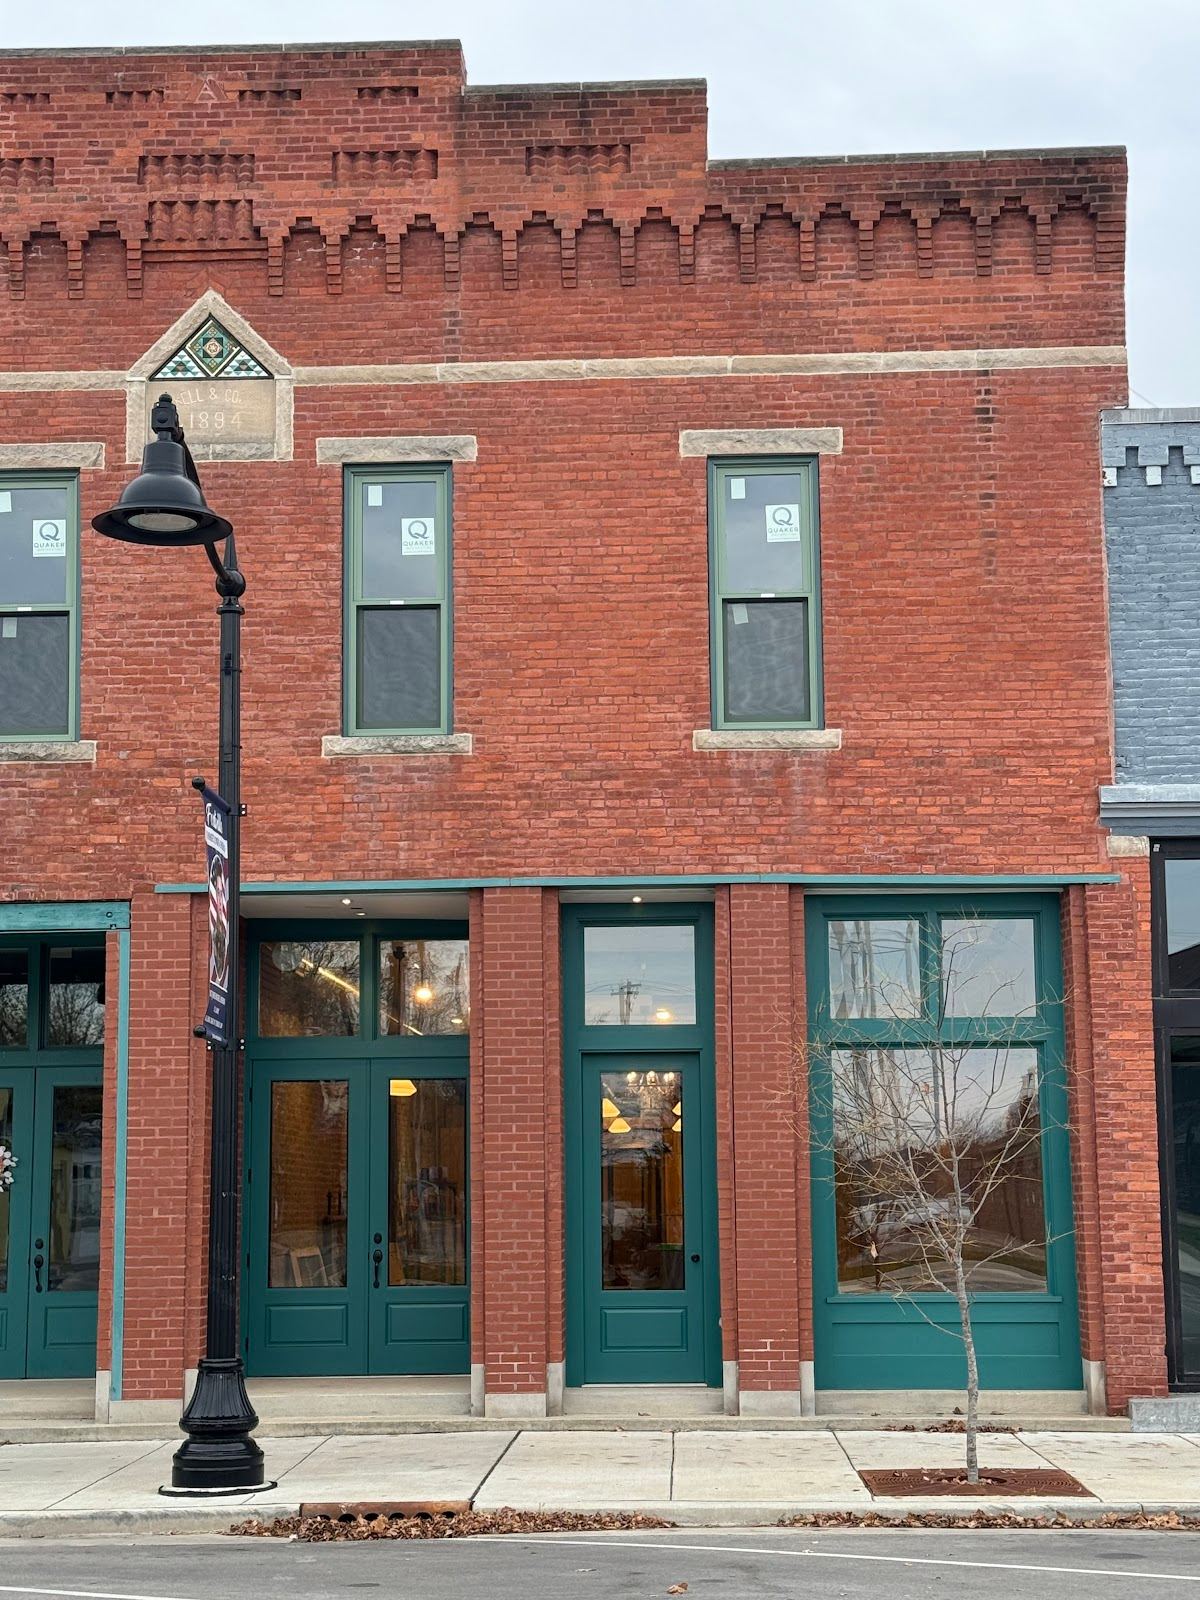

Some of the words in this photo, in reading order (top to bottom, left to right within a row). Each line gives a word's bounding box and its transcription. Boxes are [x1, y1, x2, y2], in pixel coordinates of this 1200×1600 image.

[209, 387, 217, 400] &
[190, 411, 243, 429] 1894
[768, 526, 799, 534] QUAKER
